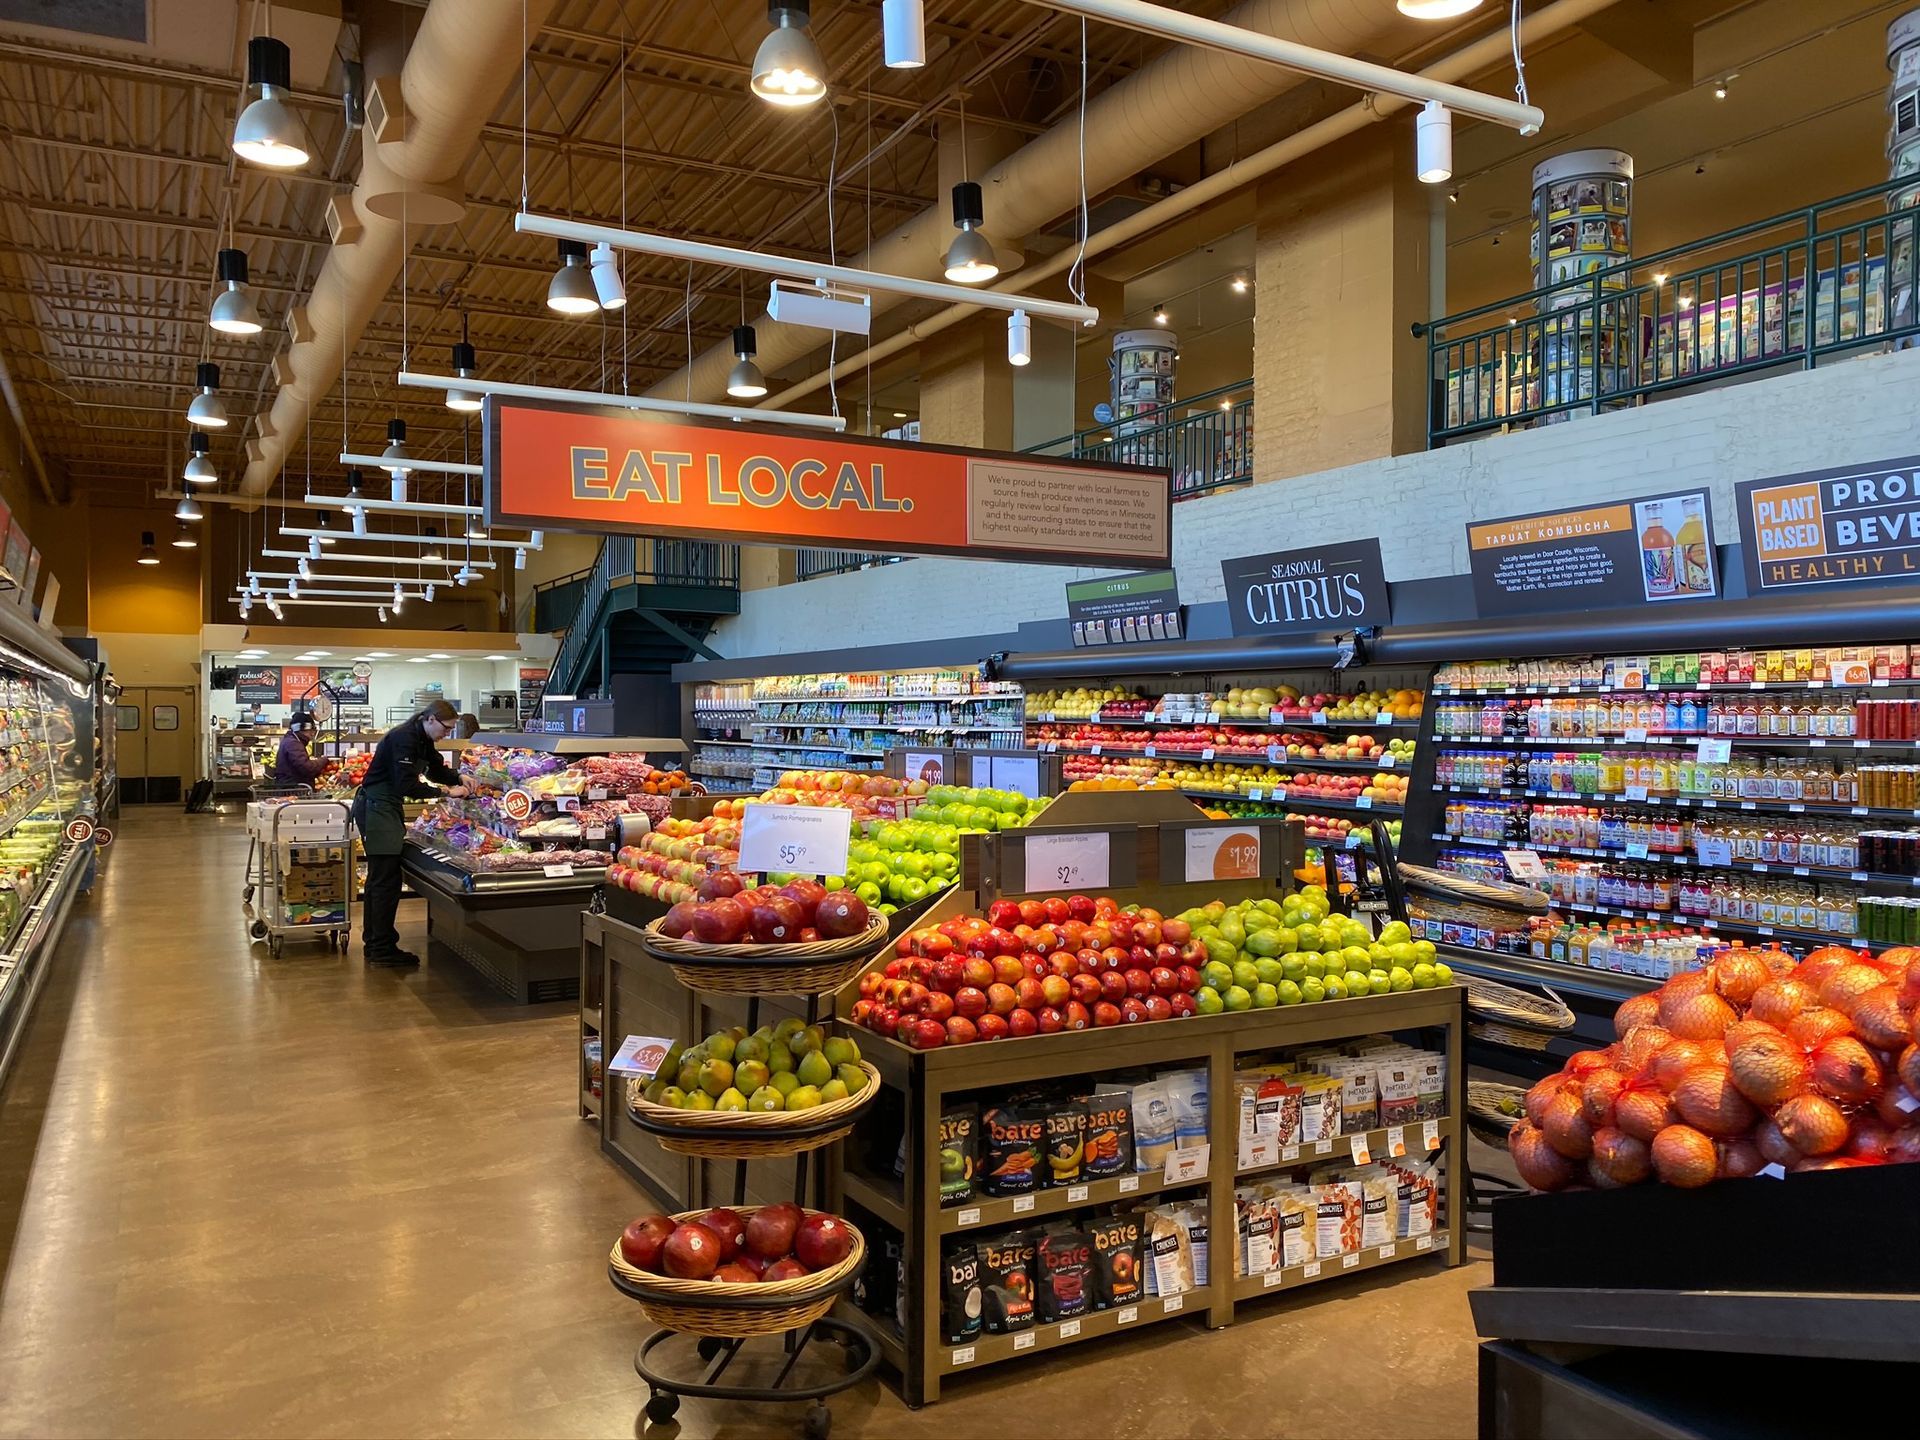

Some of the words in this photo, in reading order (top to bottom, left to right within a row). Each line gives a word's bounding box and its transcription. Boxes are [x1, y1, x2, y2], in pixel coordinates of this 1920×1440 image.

[570, 446, 692, 503] EAT
[706, 453, 914, 512] LOCAL.
[988, 474, 1010, 485] We're
[1013, 479, 1036, 488] proud
[1048, 482, 1075, 490] partner
[1078, 484, 1093, 492] with
[1095, 485, 1111, 493] local
[1114, 486, 1140, 496] farmers
[993, 488, 1018, 497] source
[1021, 489, 1039, 498] fresh
[1042, 491, 1072, 501] produce
[1074, 495, 1094, 504] when
[1133, 499, 1145, 508] We
[981, 500, 1014, 510] regularly
[1017, 502, 1041, 510] review
[1043, 502, 1060, 512] local
[1063, 504, 1079, 513] farm
[1082, 507, 1108, 516] options
[1120, 509, 1156, 520] Minnesota
[986, 511, 1000, 519] and
[1003, 512, 1016, 520] the
[1018, 515, 1062, 525] surrounding
[1065, 518, 1086, 526] states
[1124, 522, 1138, 530] that
[1758, 495, 1815, 525] PLANT
[982, 521, 1011, 532] highest
[1013, 524, 1038, 535] quality
[1040, 527, 1077, 536] standards
[1486, 531, 1530, 544] TAPUAT
[1538, 520, 1611, 538] KOMBUCHA
[1761, 524, 1820, 551] BASED
[1271, 559, 1325, 579] SEASONAL
[1772, 556, 1884, 581] HEALTHY
[1106, 583, 1130, 592] CITRUS
[1246, 573, 1365, 625] CITRUS
[286, 675, 315, 684] BEEF
[507, 797, 527, 811] DEAL
[1230, 846, 1258, 869] $1.99
[637, 1049, 664, 1063] $3.49
[940, 1120, 970, 1141] are
[991, 1120, 1042, 1140] bare
[1092, 1224, 1138, 1250] bare
[1156, 1237, 1177, 1251] CRUNCHIES
[986, 1247, 1035, 1268] bare
[1046, 1246, 1090, 1268] bare
[951, 1261, 978, 1285] bar
